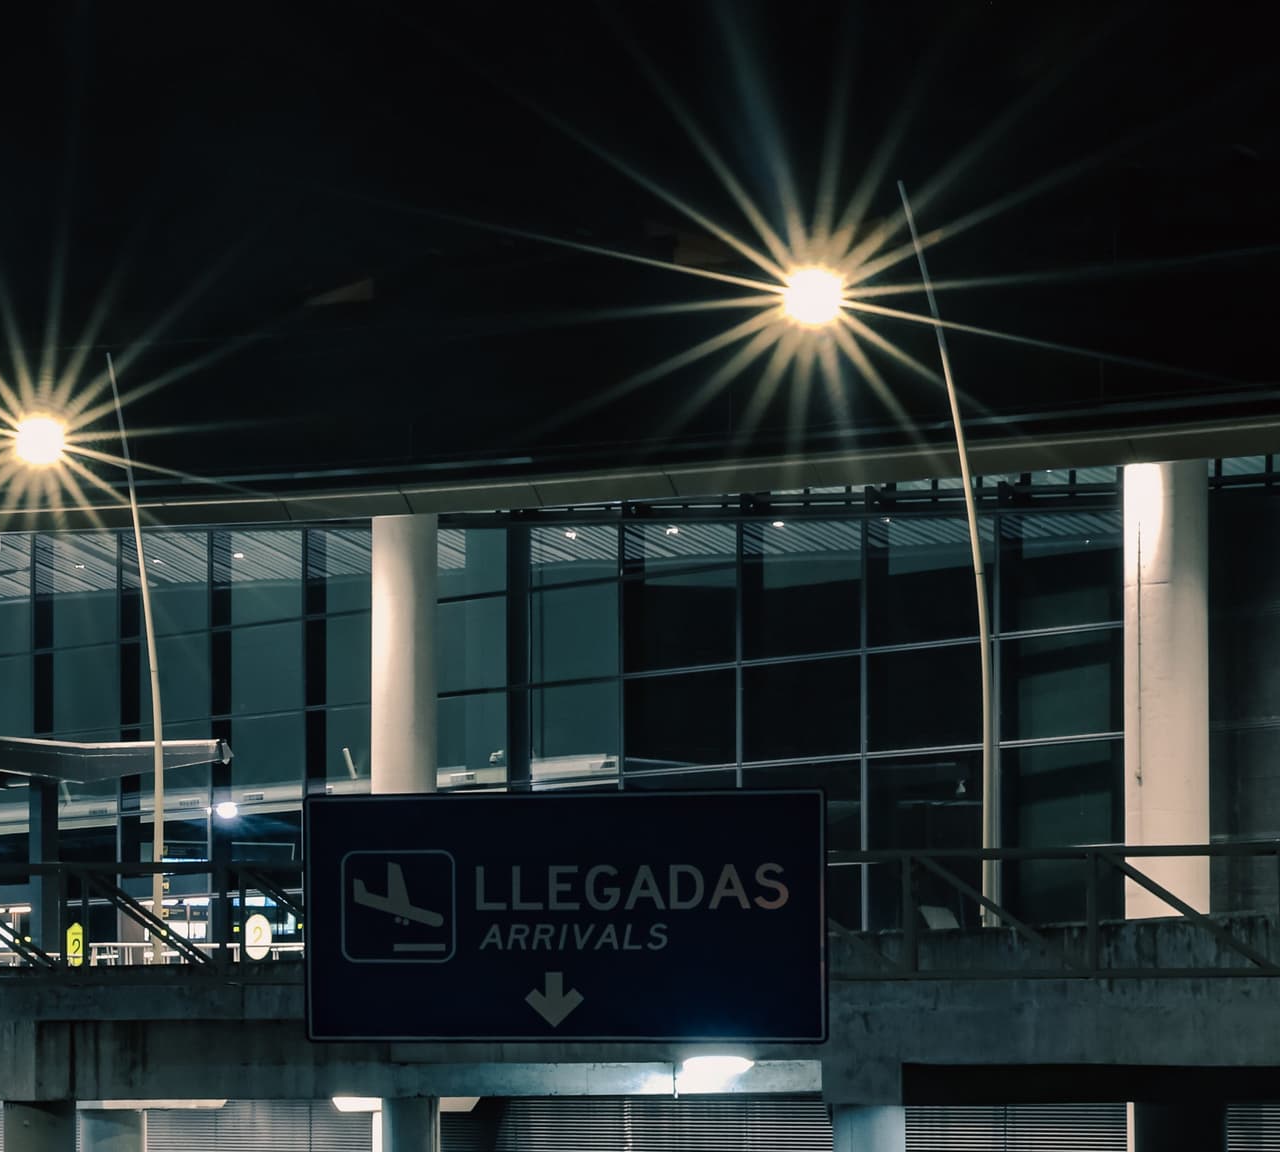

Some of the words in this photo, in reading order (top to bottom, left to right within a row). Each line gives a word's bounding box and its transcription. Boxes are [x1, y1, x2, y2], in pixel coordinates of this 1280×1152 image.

[475, 864, 790, 911] LLEGADAS
[72, 938, 81, 957] 2
[479, 922, 669, 951] ARRIVALS
